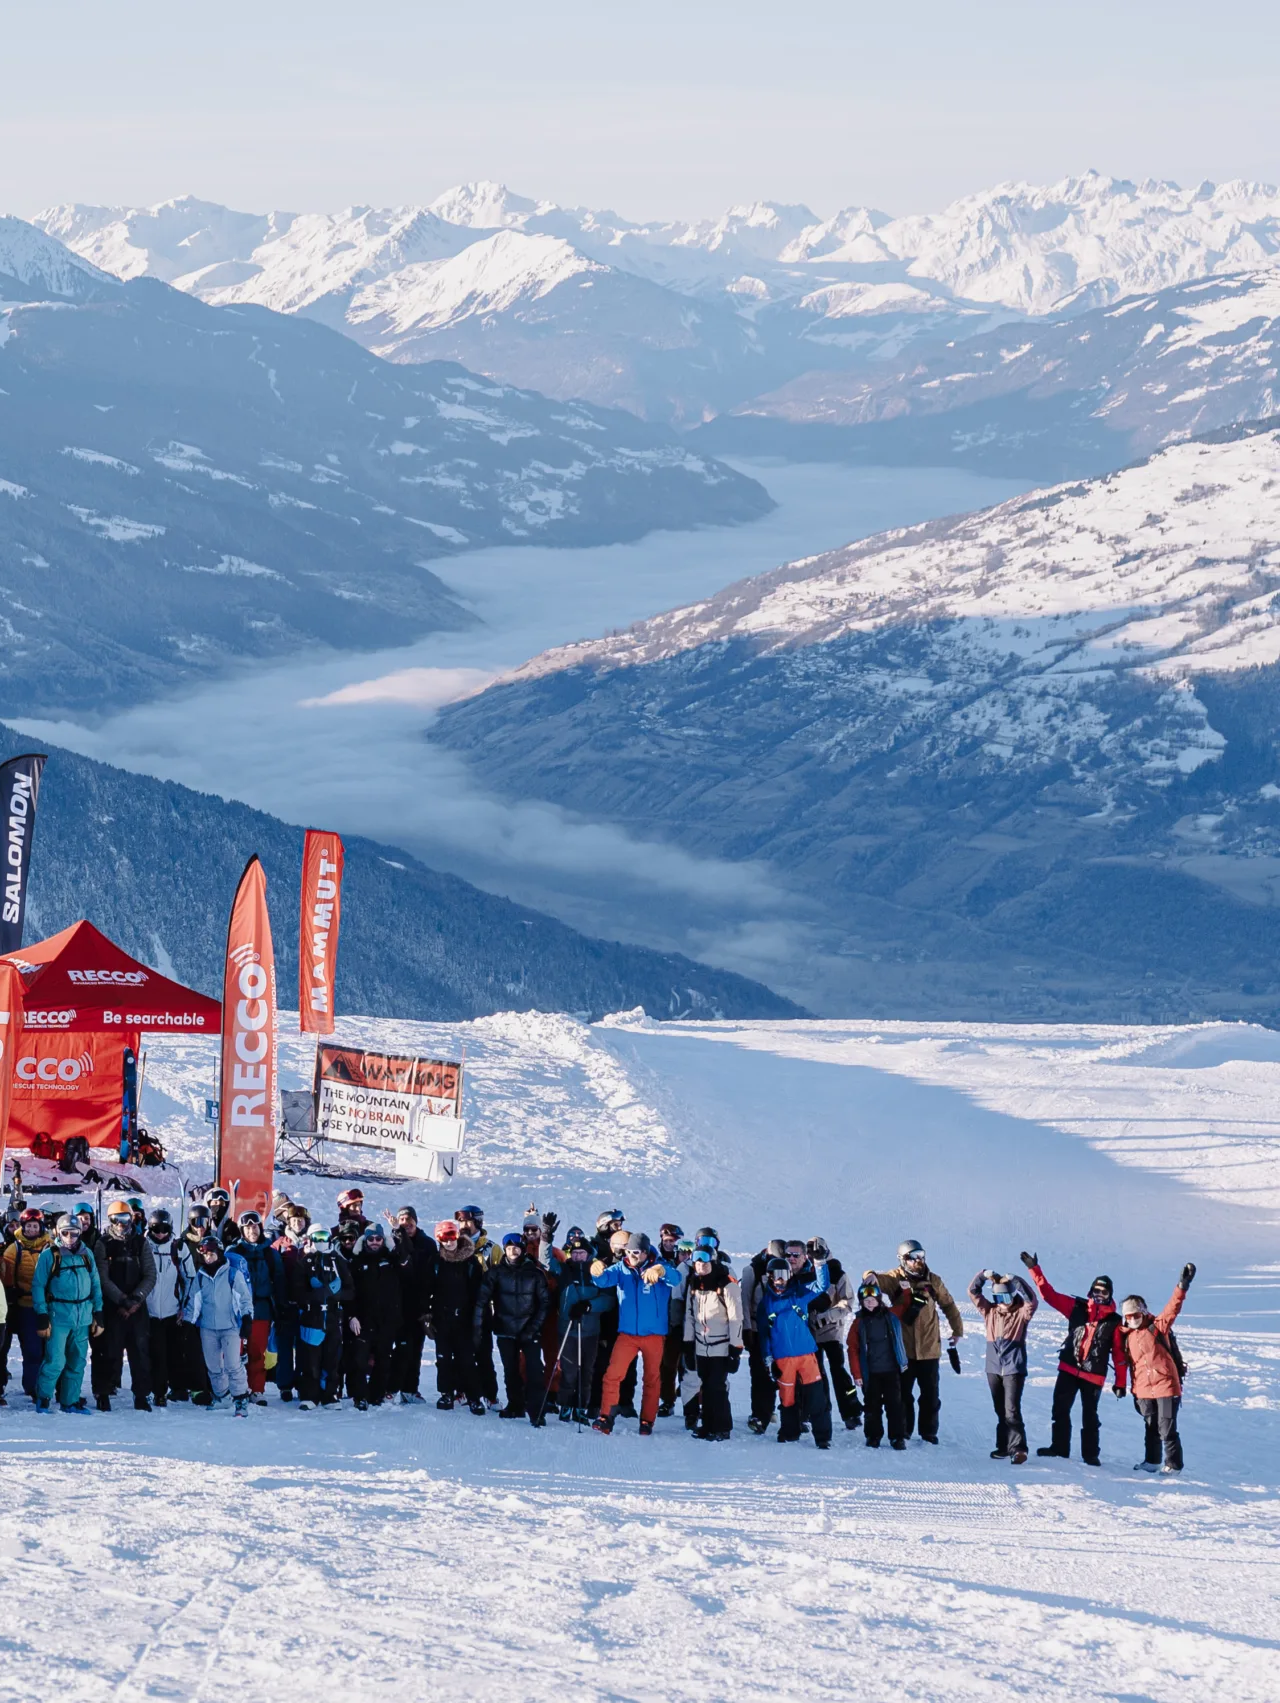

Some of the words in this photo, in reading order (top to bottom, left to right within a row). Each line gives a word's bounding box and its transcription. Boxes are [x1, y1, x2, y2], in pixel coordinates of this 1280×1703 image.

[2, 771, 33, 925] SALOMON
[67, 969, 142, 984] RECCO
[103, 1011, 121, 1025] Be
[125, 1012, 206, 1026] searchable
[230, 962, 269, 1128] RECCO
[16, 1056, 81, 1082] CCO
[36, 1083, 80, 1091] TECHNOLOGY
[323, 1086, 344, 1099] THE
[346, 1094, 411, 1111] MOUNTAIN
[322, 1103, 347, 1116] HAS
[348, 1106, 367, 1119] NO
[369, 1110, 405, 1125] BRAIN
[345, 1122, 378, 1137] YOUR
[380, 1128, 414, 1143] OWN.
